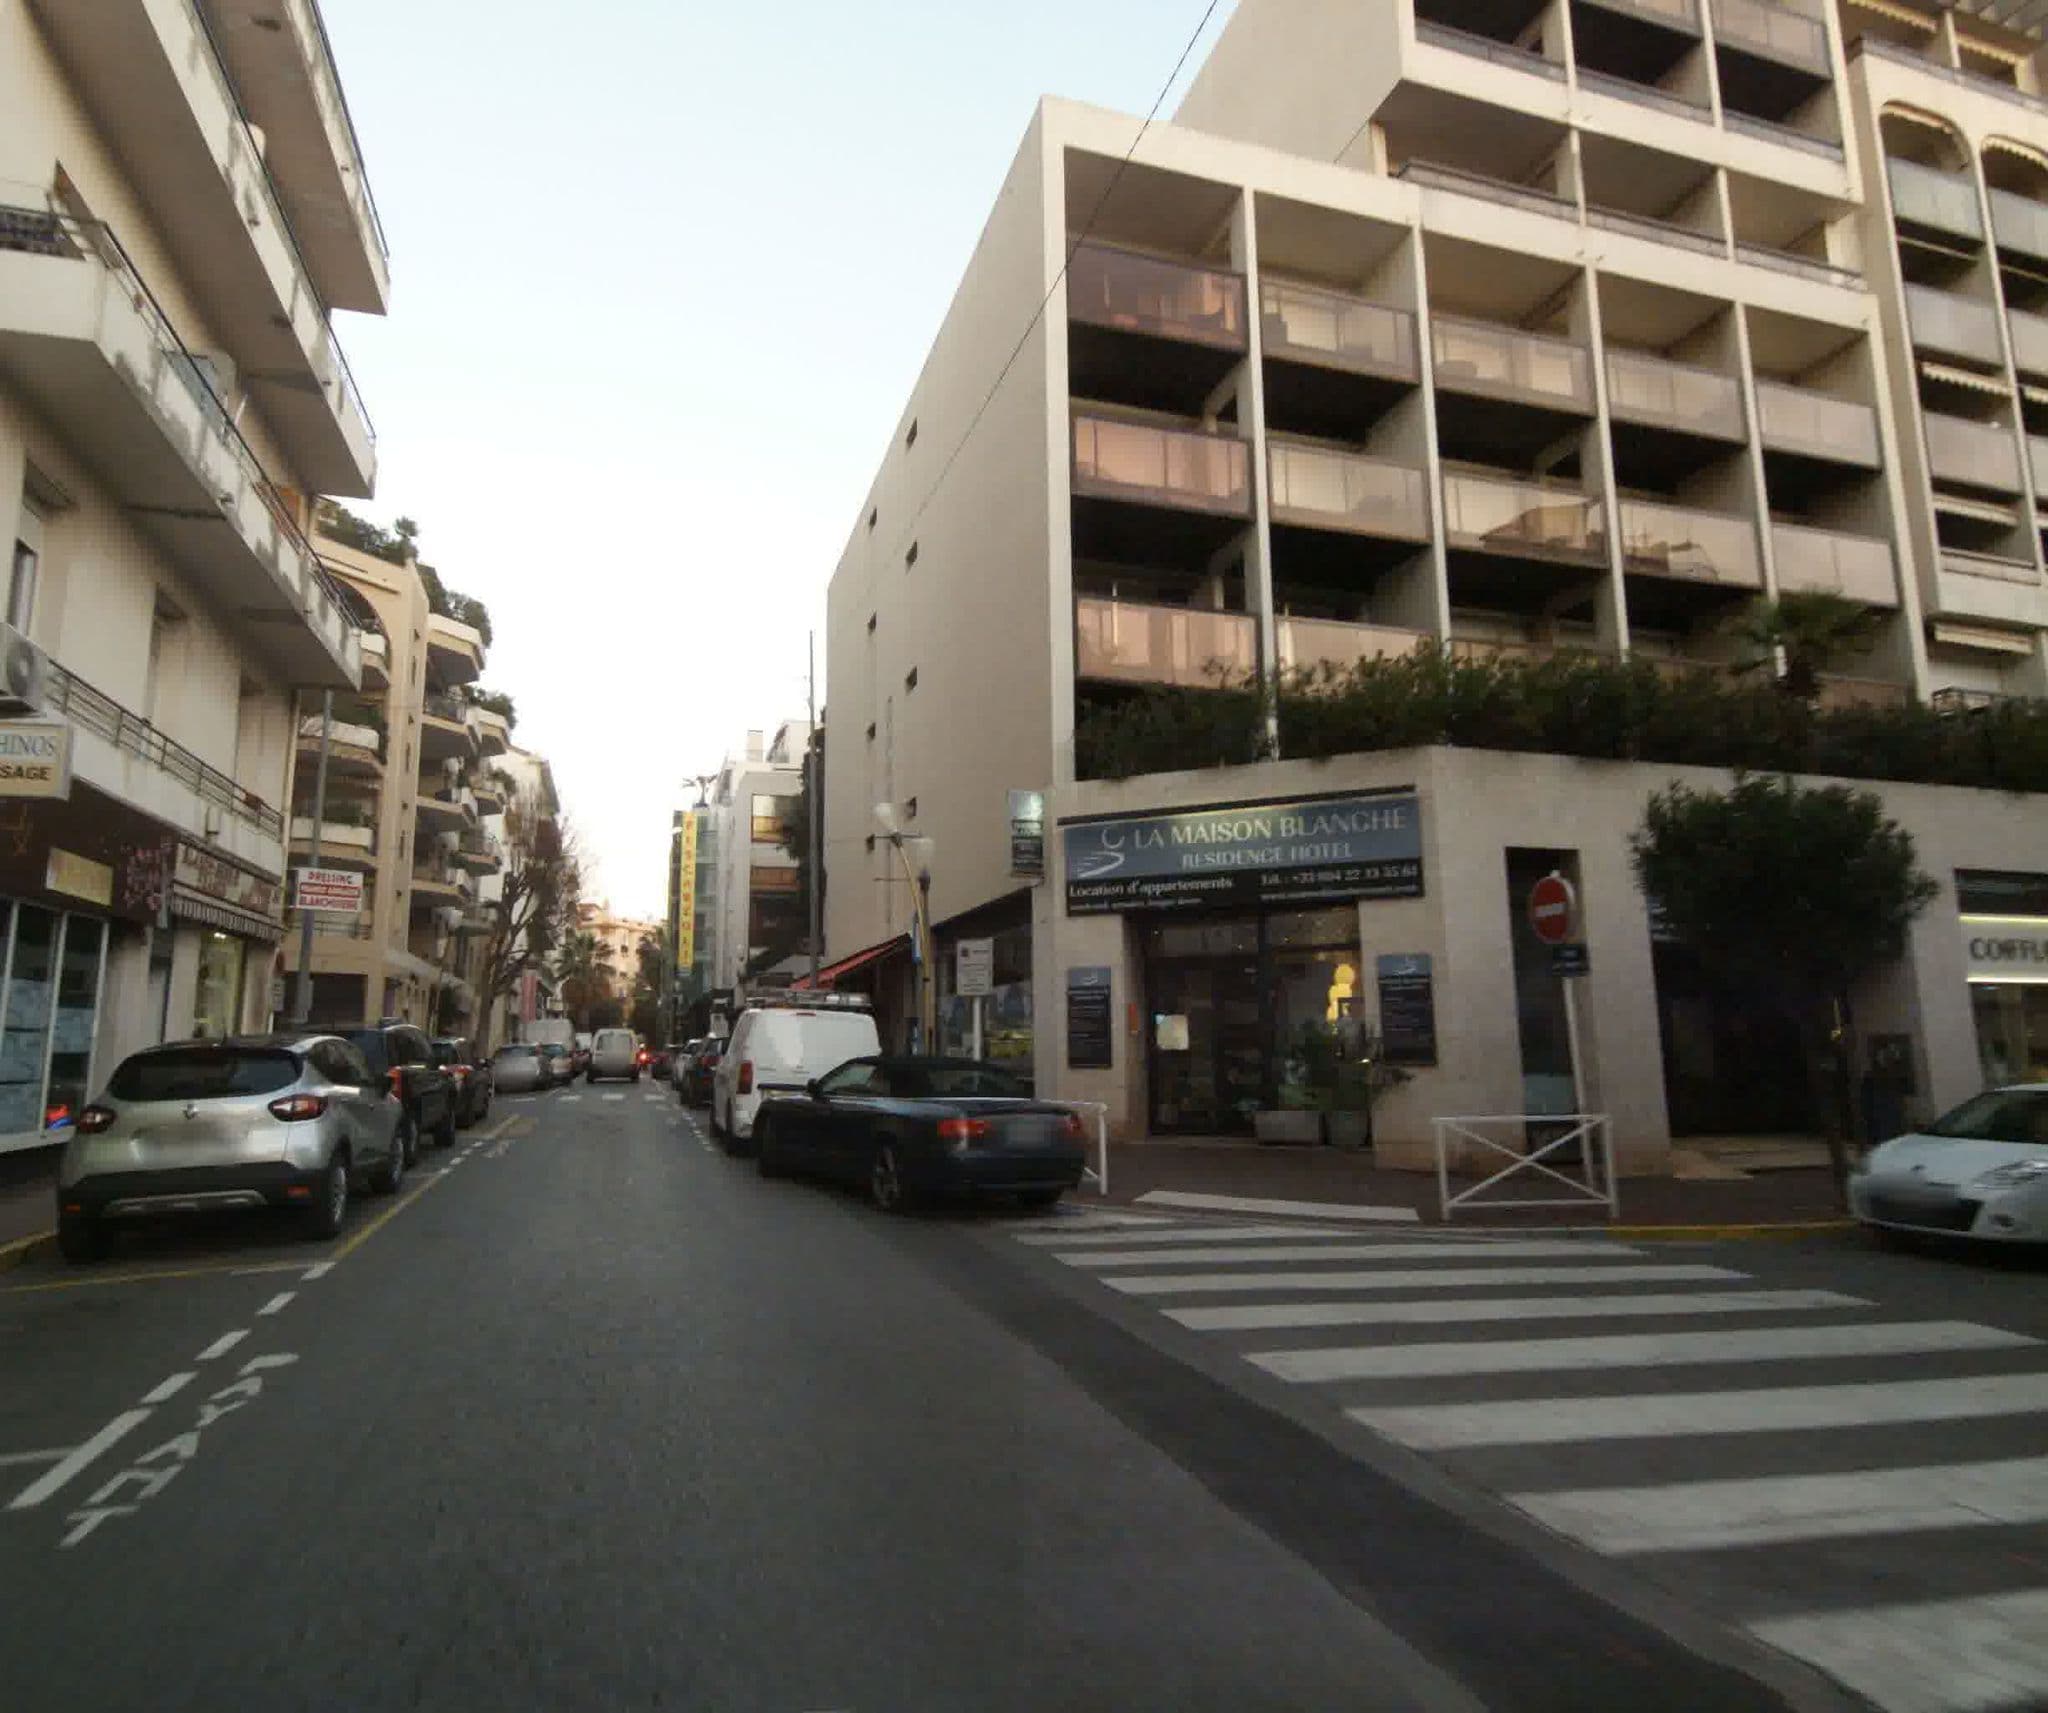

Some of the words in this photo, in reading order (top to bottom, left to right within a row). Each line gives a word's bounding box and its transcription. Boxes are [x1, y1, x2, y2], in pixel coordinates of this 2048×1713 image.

[1134, 829, 1164, 849] LA
[1171, 818, 1272, 845] MAISON
[1280, 807, 1407, 838] BLANCHE
[1070, 881, 1124, 897] Location
[56, 1351, 300, 1550] PAYANT
